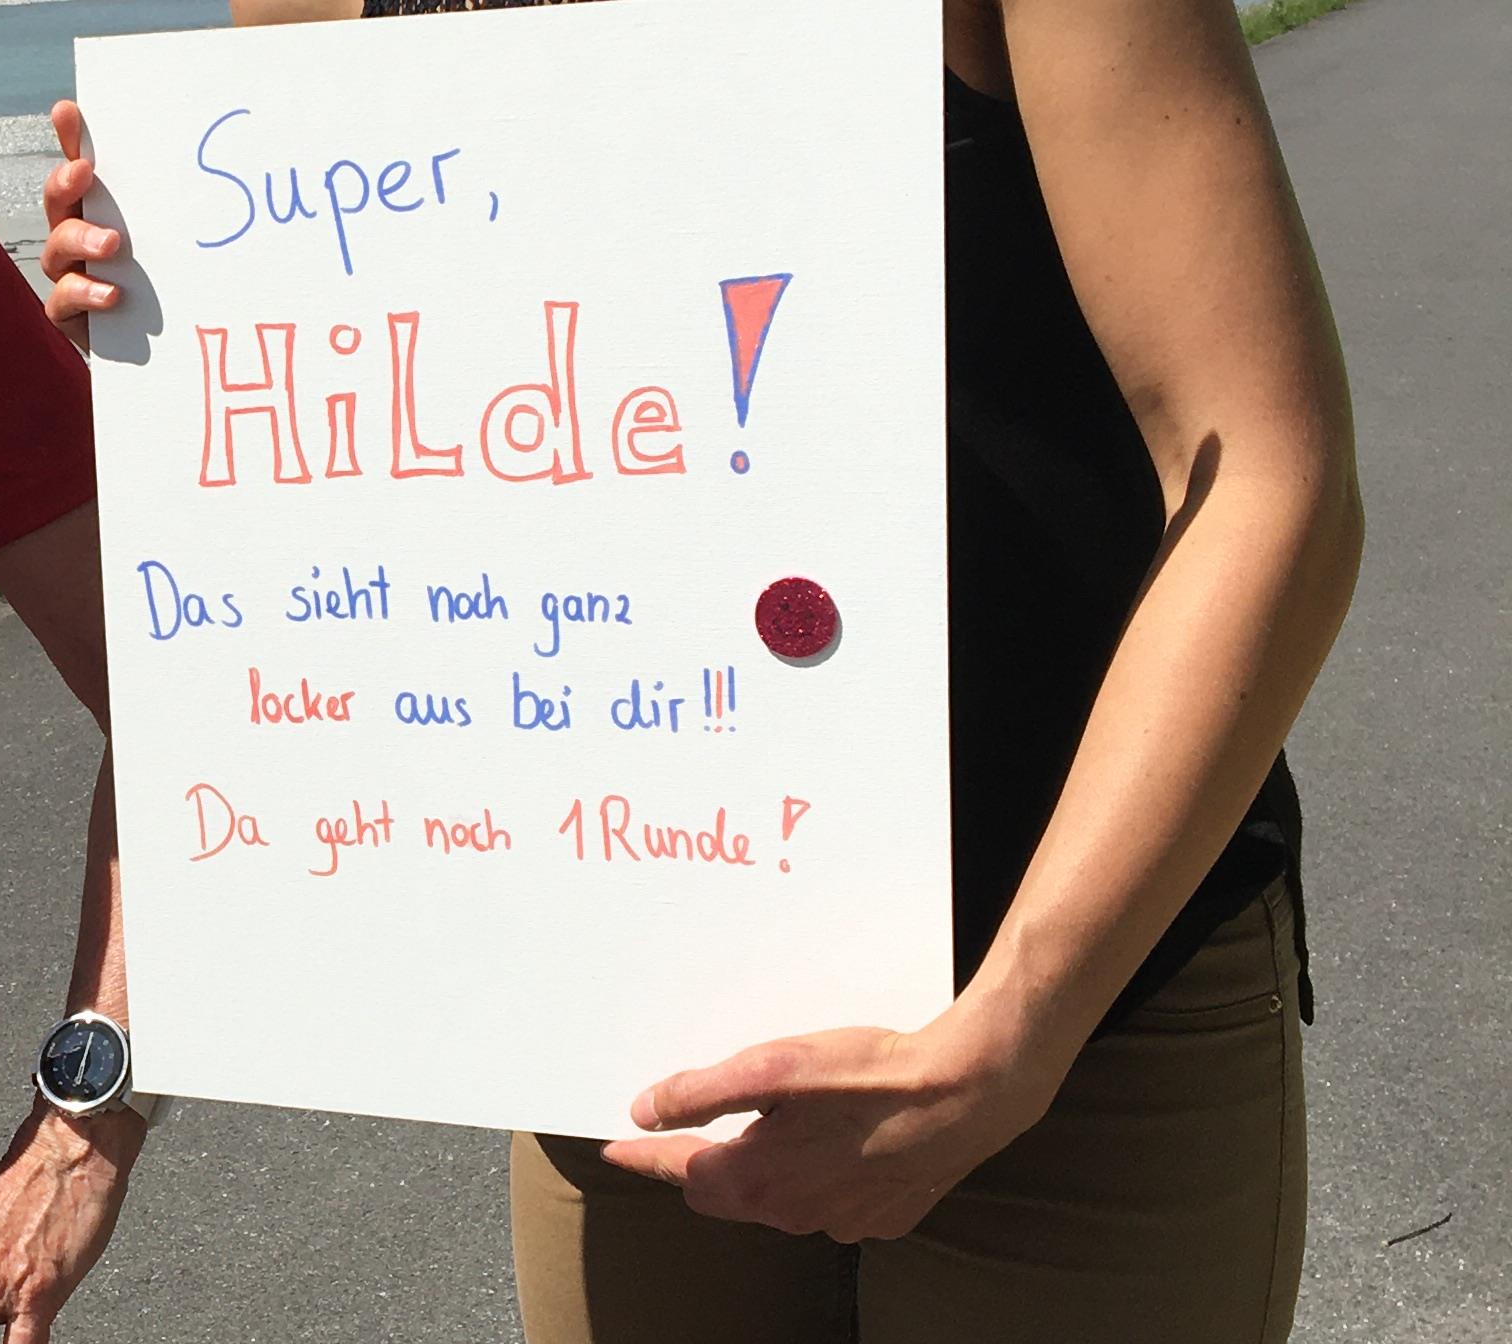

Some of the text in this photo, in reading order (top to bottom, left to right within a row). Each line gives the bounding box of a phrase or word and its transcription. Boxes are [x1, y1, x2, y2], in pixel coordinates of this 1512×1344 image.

[197, 109, 500, 274] Super,
[137, 559, 634, 658] Das sieht noch ganz
[248, 667, 355, 725] locker
[394, 691, 472, 727] aus
[512, 671, 573, 732] bei
[185, 782, 270, 862] Da
[307, 799, 395, 877] geht
[424, 808, 512, 854] noch
